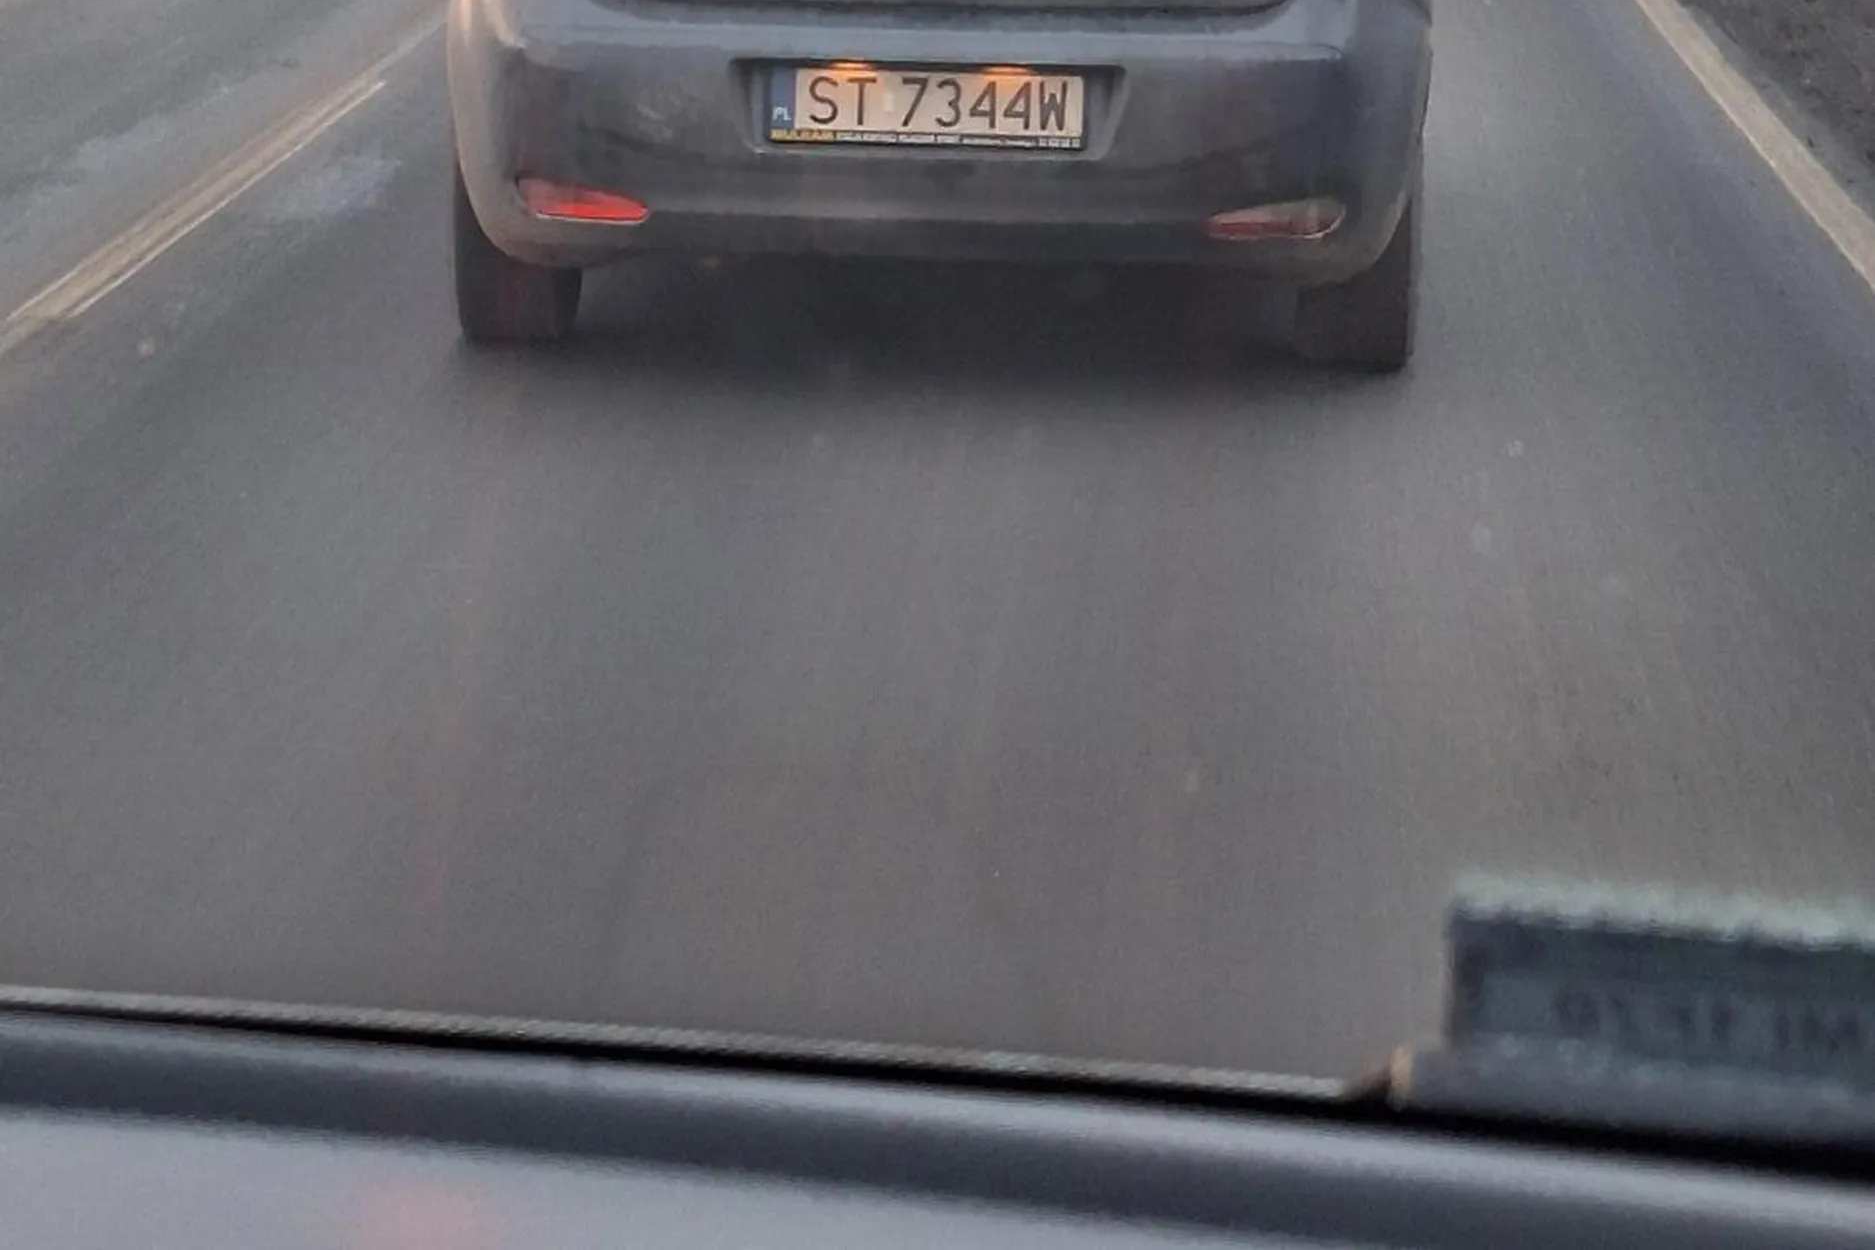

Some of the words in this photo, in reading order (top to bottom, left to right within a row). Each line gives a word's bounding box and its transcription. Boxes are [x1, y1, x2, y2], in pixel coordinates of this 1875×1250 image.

[772, 106, 792, 122] PL
[808, 76, 877, 126] ST
[901, 76, 1070, 131] 7344W
